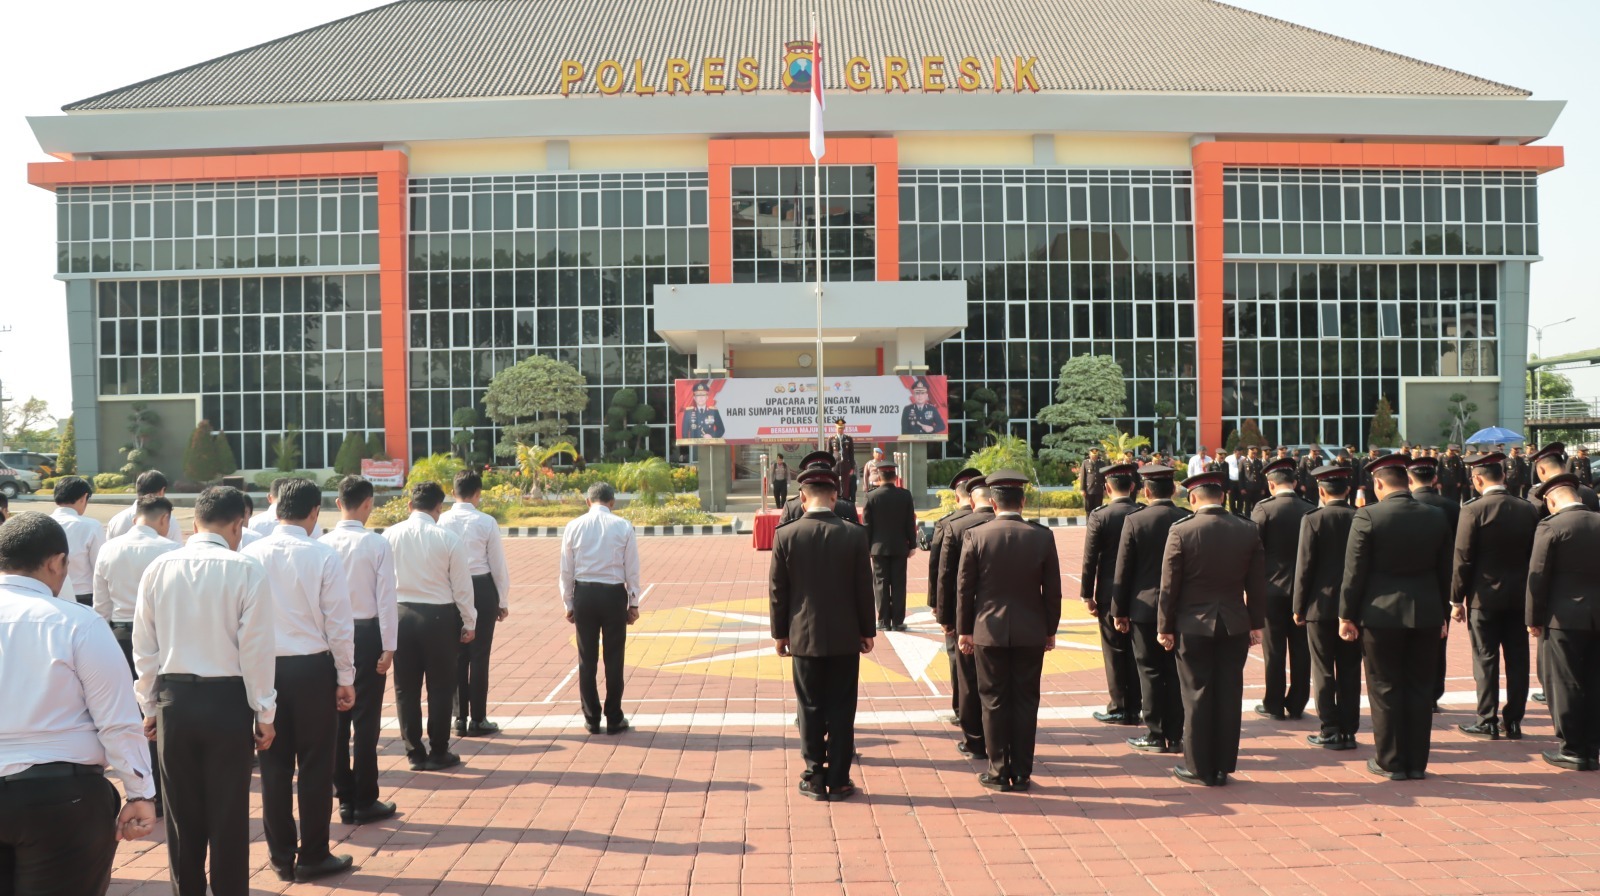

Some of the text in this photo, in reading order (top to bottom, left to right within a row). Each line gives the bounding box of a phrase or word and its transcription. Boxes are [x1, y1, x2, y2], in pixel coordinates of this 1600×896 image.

[561, 55, 1040, 95] POLRES GRESIK
[765, 396, 860, 406] UPACARA PEINGATAN
[726, 407, 746, 416] HARI
[748, 406, 784, 416] SUMPAH
[823, 405, 848, 414] KE-95
[850, 404, 877, 414] TAHUN
[880, 404, 900, 414] 2023
[780, 416, 812, 424] POLRES
